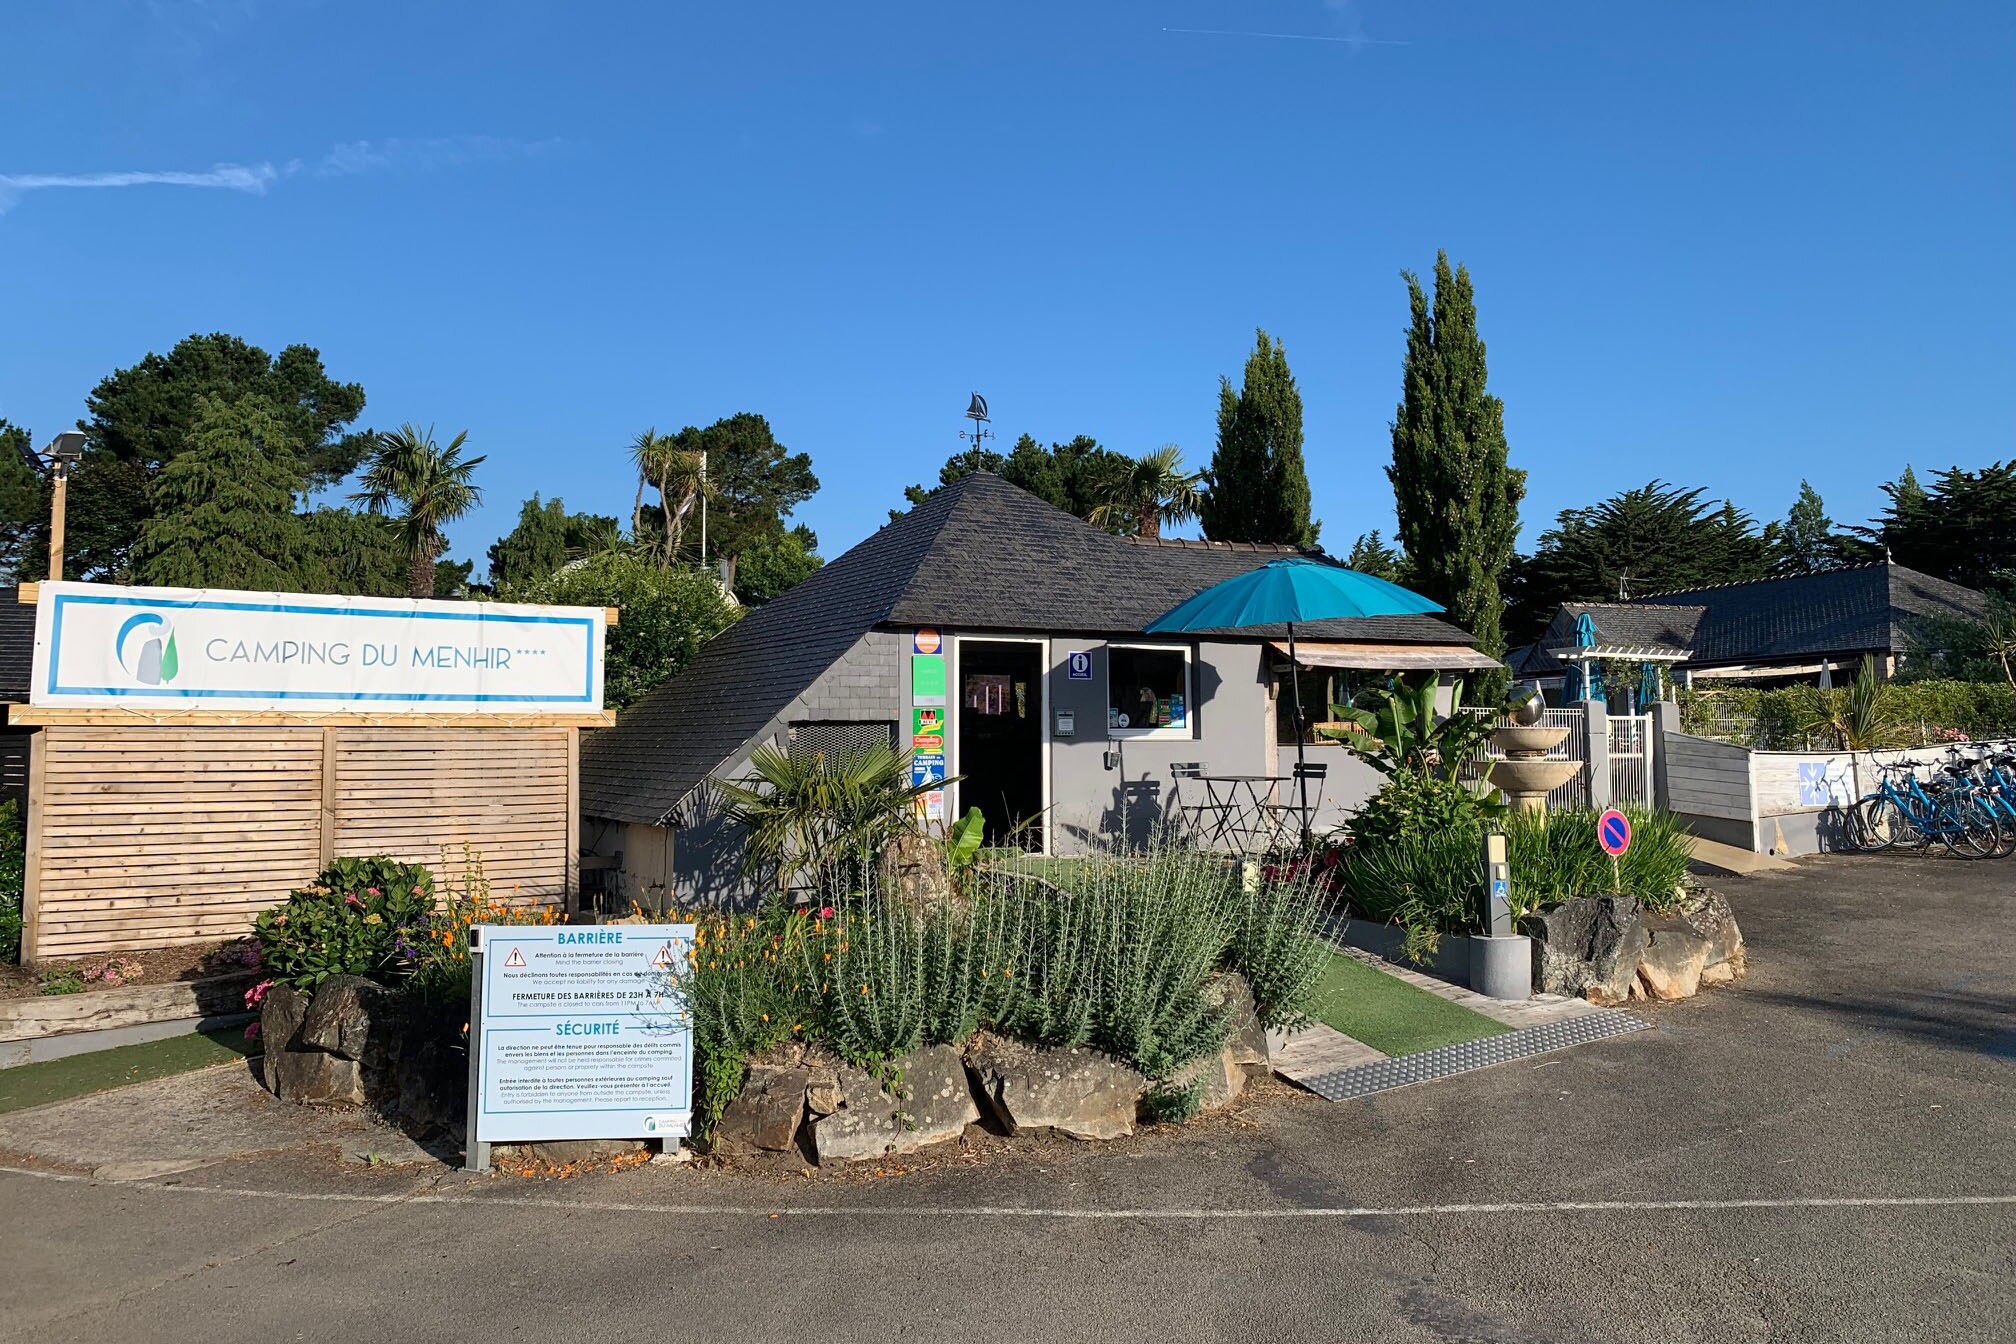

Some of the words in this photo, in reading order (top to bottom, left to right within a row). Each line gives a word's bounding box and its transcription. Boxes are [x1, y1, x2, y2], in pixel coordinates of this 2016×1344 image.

[206, 638, 351, 665] CAMPING
[362, 643, 398, 667] DU
[412, 646, 510, 669] MENHIR
[558, 929, 623, 944] BARRIÈRE
[574, 990, 614, 999] BARRIÈRES
[556, 1020, 620, 1035] SÉCURITÉ
